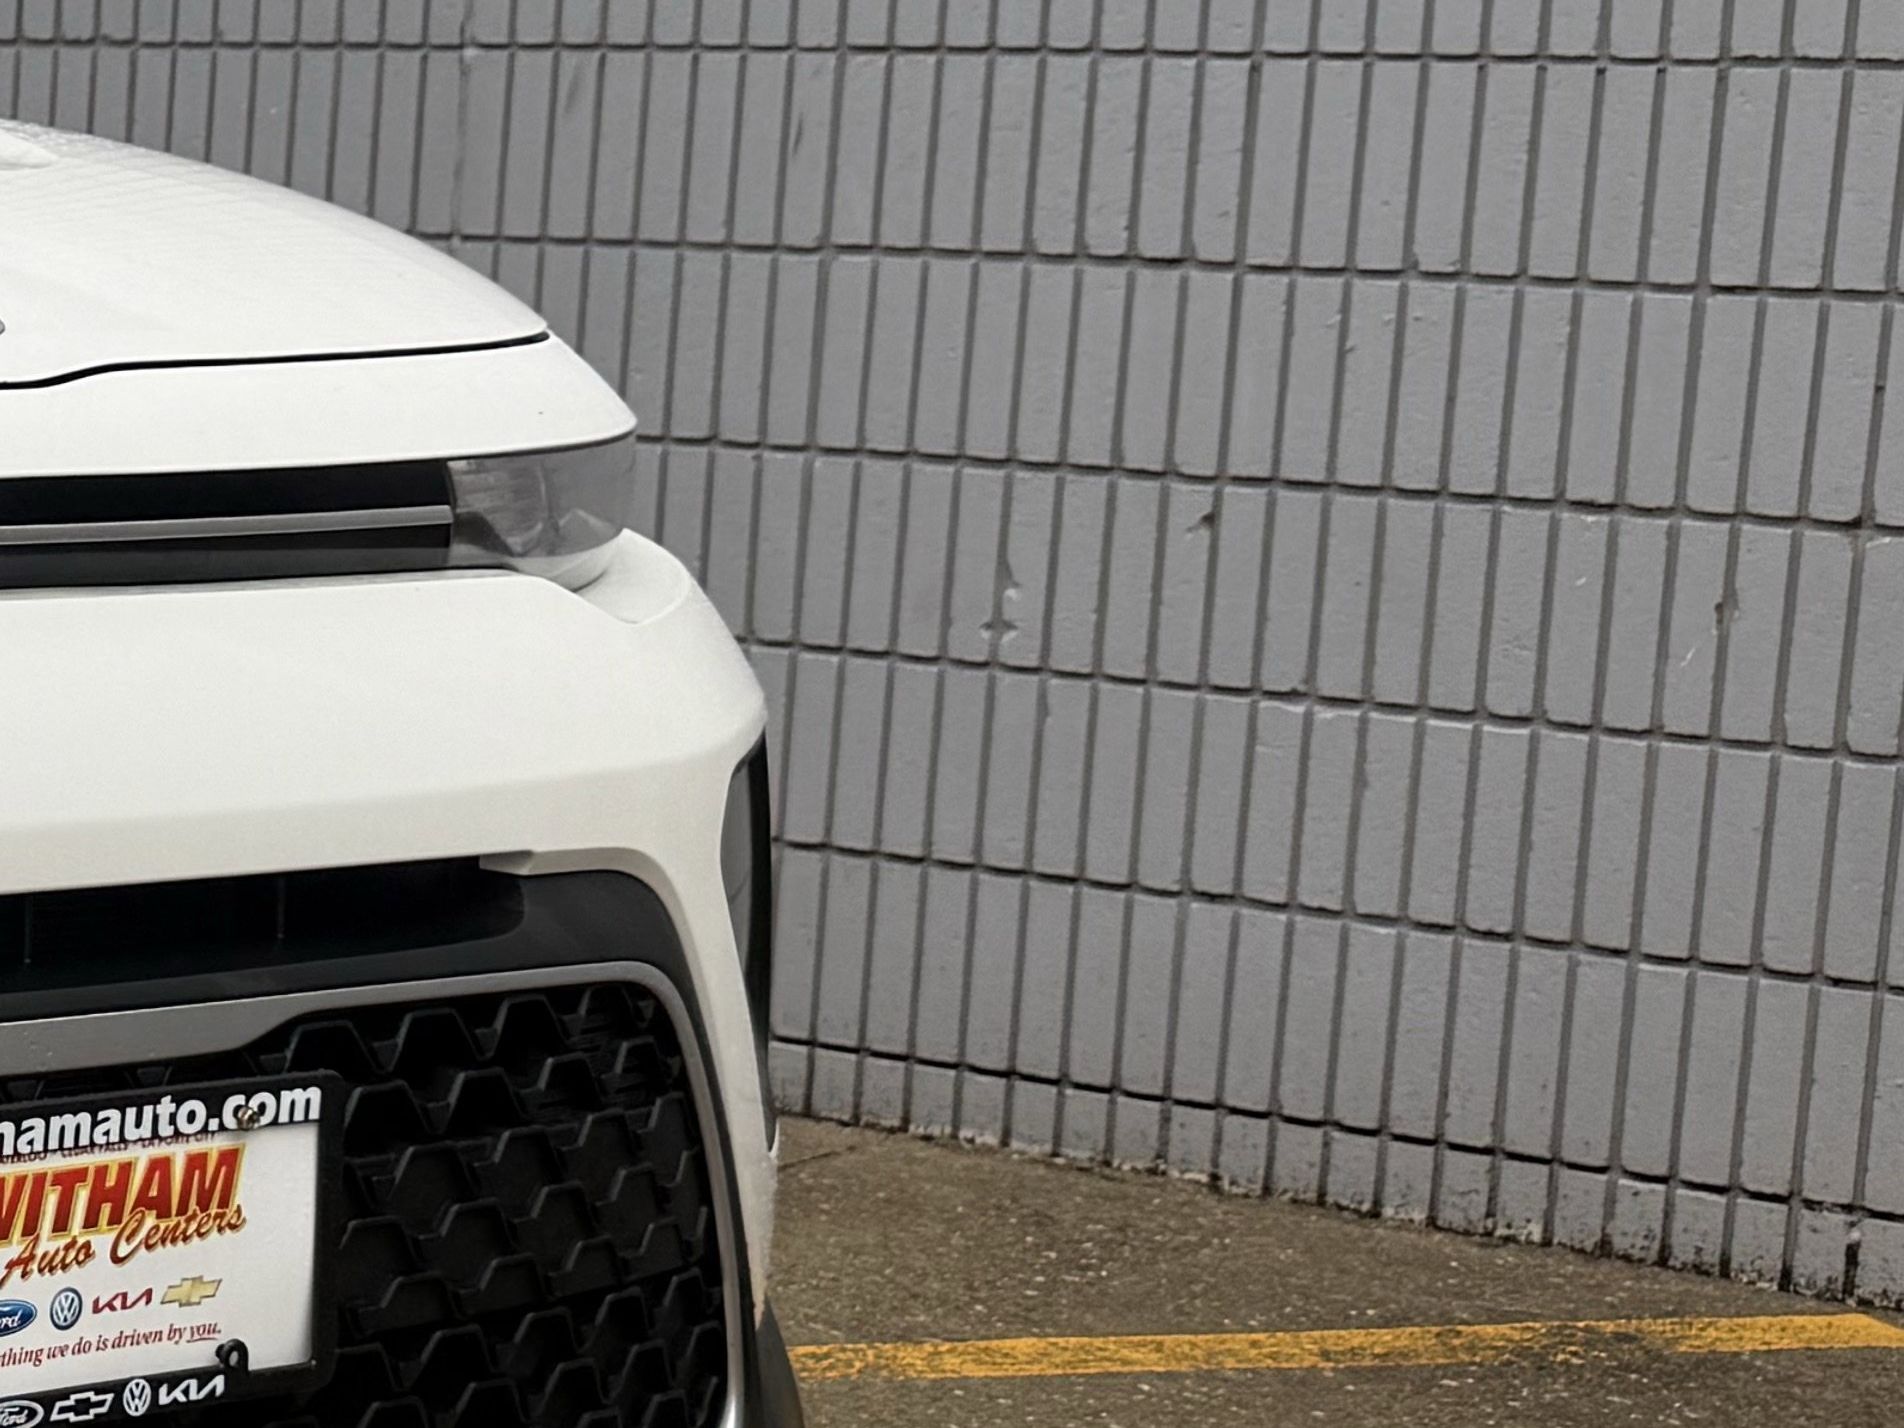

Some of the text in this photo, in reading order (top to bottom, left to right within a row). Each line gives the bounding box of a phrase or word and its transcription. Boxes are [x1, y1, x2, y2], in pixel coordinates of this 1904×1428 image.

[109, 1204, 247, 1268] Centers
[92, 1286, 154, 1315] KIA
[46, 1343, 70, 1360] we
[71, 1336, 93, 1356] do
[95, 1334, 110, 1352] is
[111, 1329, 164, 1350] driven
[166, 1323, 187, 1345] by
[186, 1322, 222, 1342] you.
[157, 1374, 226, 1406] KIA
